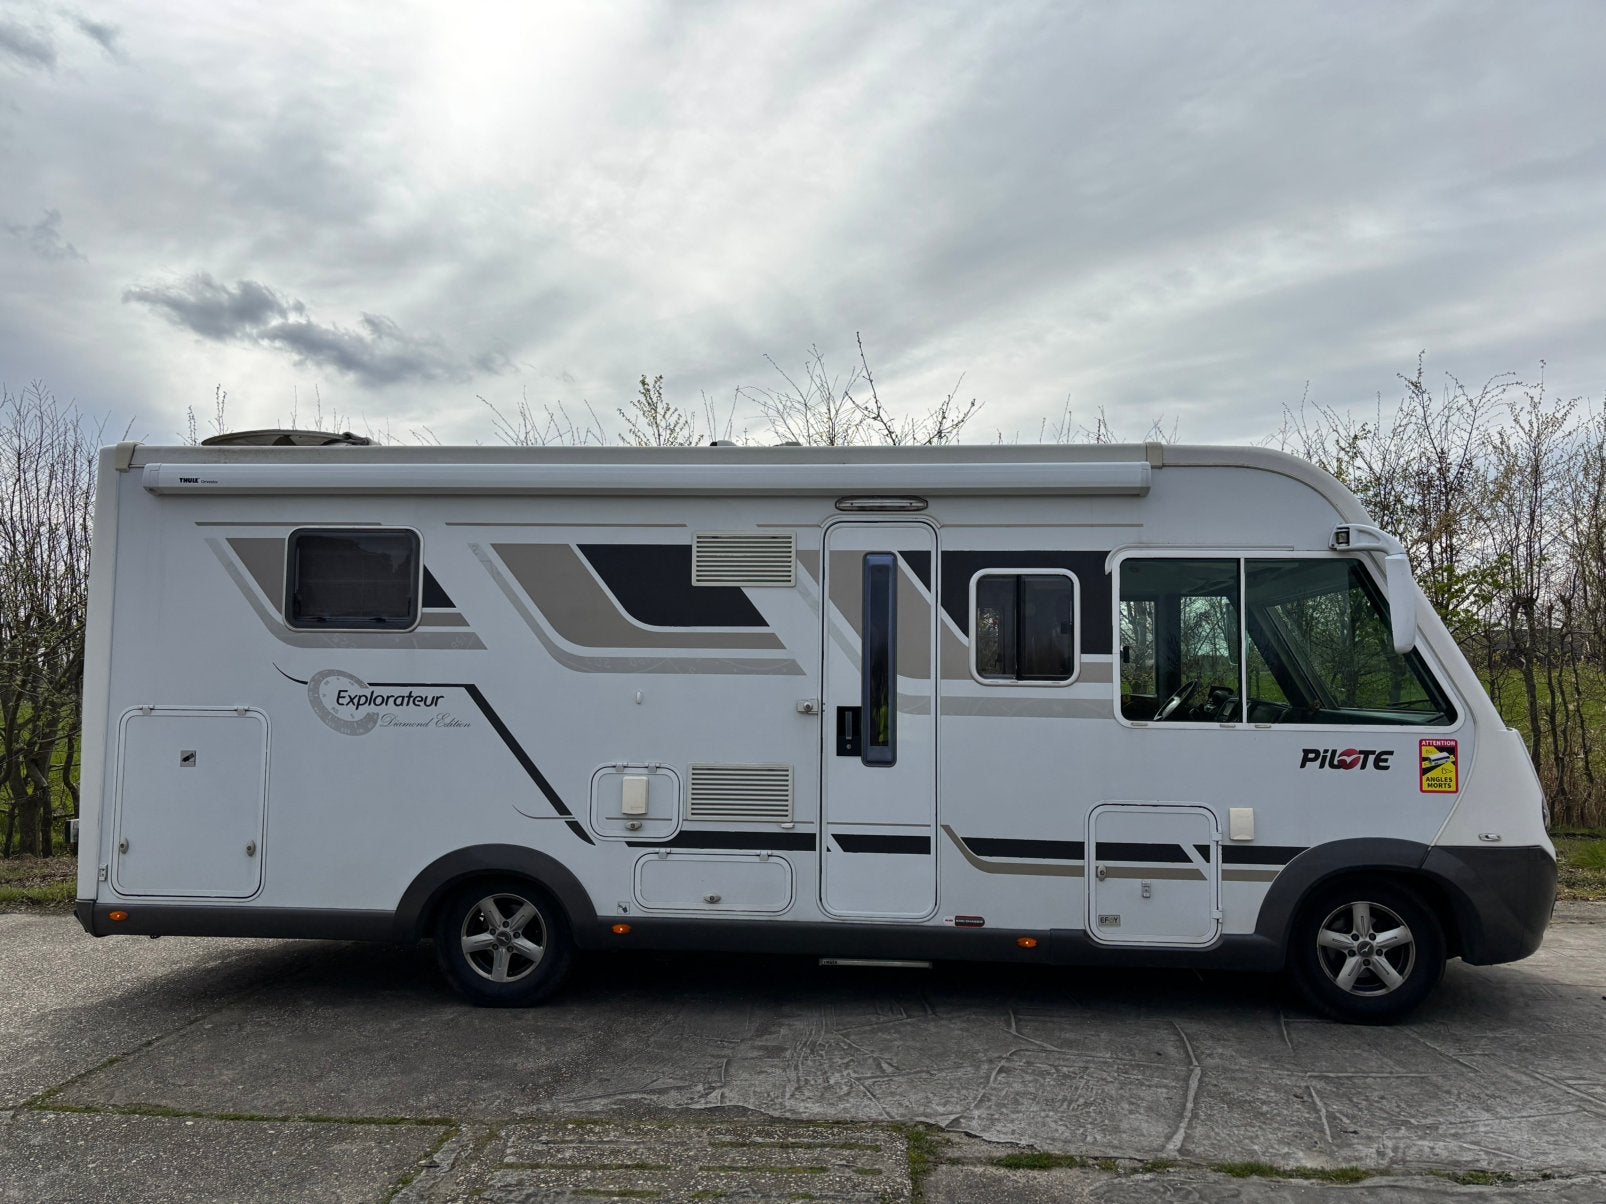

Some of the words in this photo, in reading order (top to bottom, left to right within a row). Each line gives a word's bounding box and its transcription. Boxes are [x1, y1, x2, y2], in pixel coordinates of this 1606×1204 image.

[336, 690, 445, 711] Explorateur
[379, 712, 433, 728] Diamond
[435, 712, 472, 728] Edition
